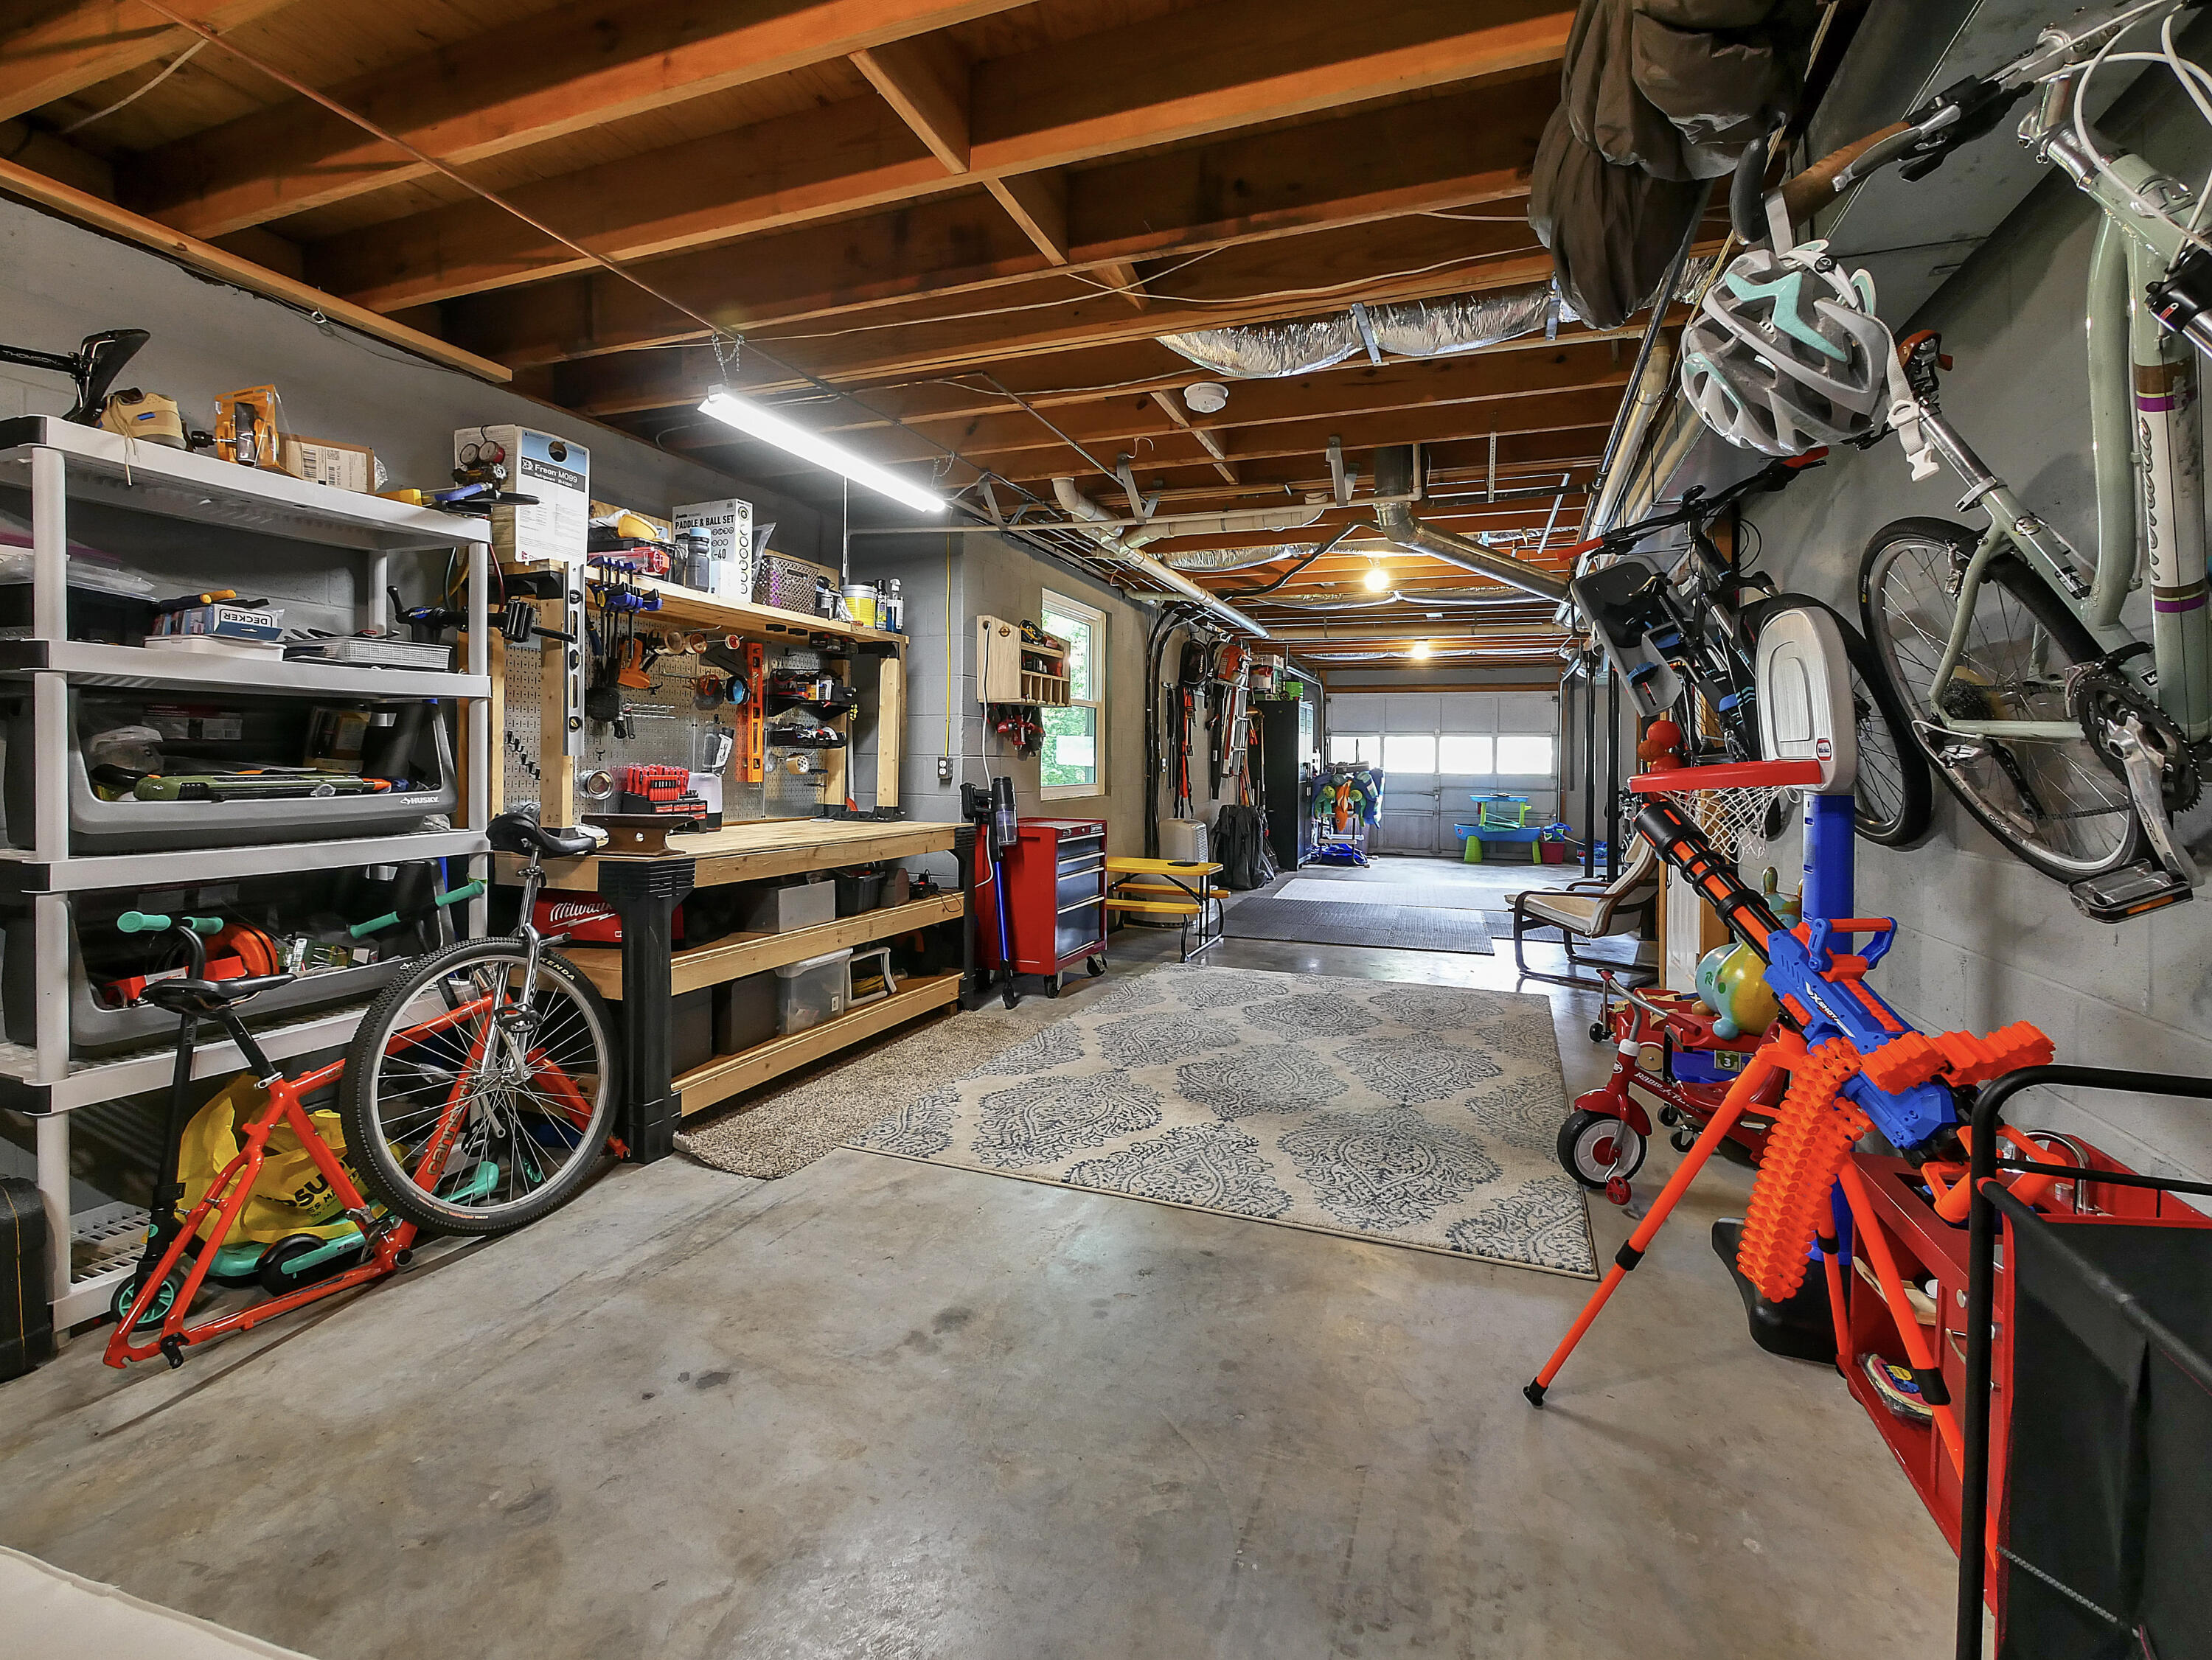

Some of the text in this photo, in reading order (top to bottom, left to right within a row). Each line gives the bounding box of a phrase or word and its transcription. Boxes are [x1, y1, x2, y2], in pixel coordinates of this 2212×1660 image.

[2, 349, 58, 364] THOMSON
[535, 464, 557, 476] Freon
[675, 519, 698, 530] PADDLE
[699, 518, 704, 526] &
[706, 516, 721, 526] BALL
[723, 515, 735, 524] SET
[223, 613, 268, 625] DECKER
[410, 796, 439, 804] HUSKY
[539, 956, 575, 980] KENDA
[1723, 1059, 1731, 1067] 3
